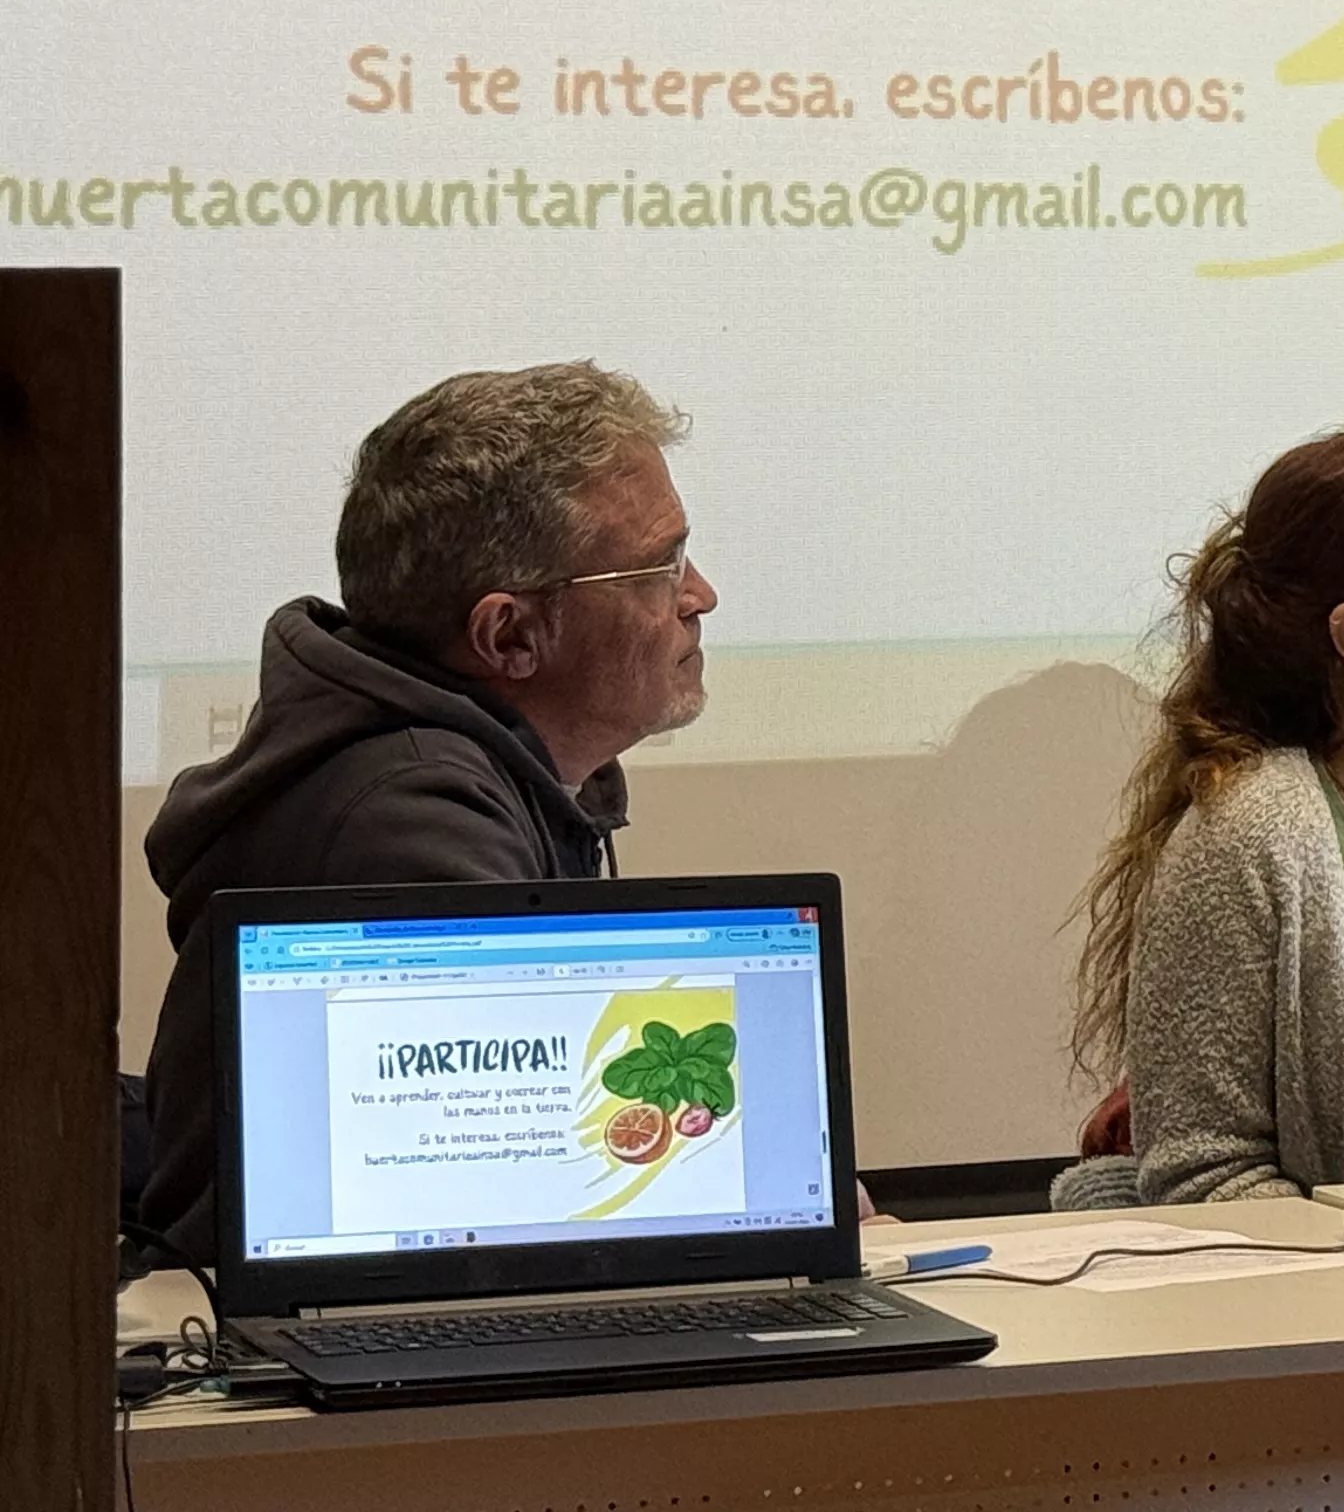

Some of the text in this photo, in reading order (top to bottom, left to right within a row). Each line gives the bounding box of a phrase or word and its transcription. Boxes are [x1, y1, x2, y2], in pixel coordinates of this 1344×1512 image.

[346, 43, 413, 115] Si
[445, 54, 521, 116] te
[886, 49, 1246, 124] escríbenos:
[377, 1035, 569, 1080] ¡¡PARTICIPA!!
[351, 1091, 375, 1105] Ven
[447, 1087, 492, 1101] cultivar
[494, 1088, 503, 1102] y
[443, 1105, 461, 1118] las
[504, 1105, 518, 1115] en
[418, 1132, 430, 1146] Si
[434, 1133, 447, 1145] te
